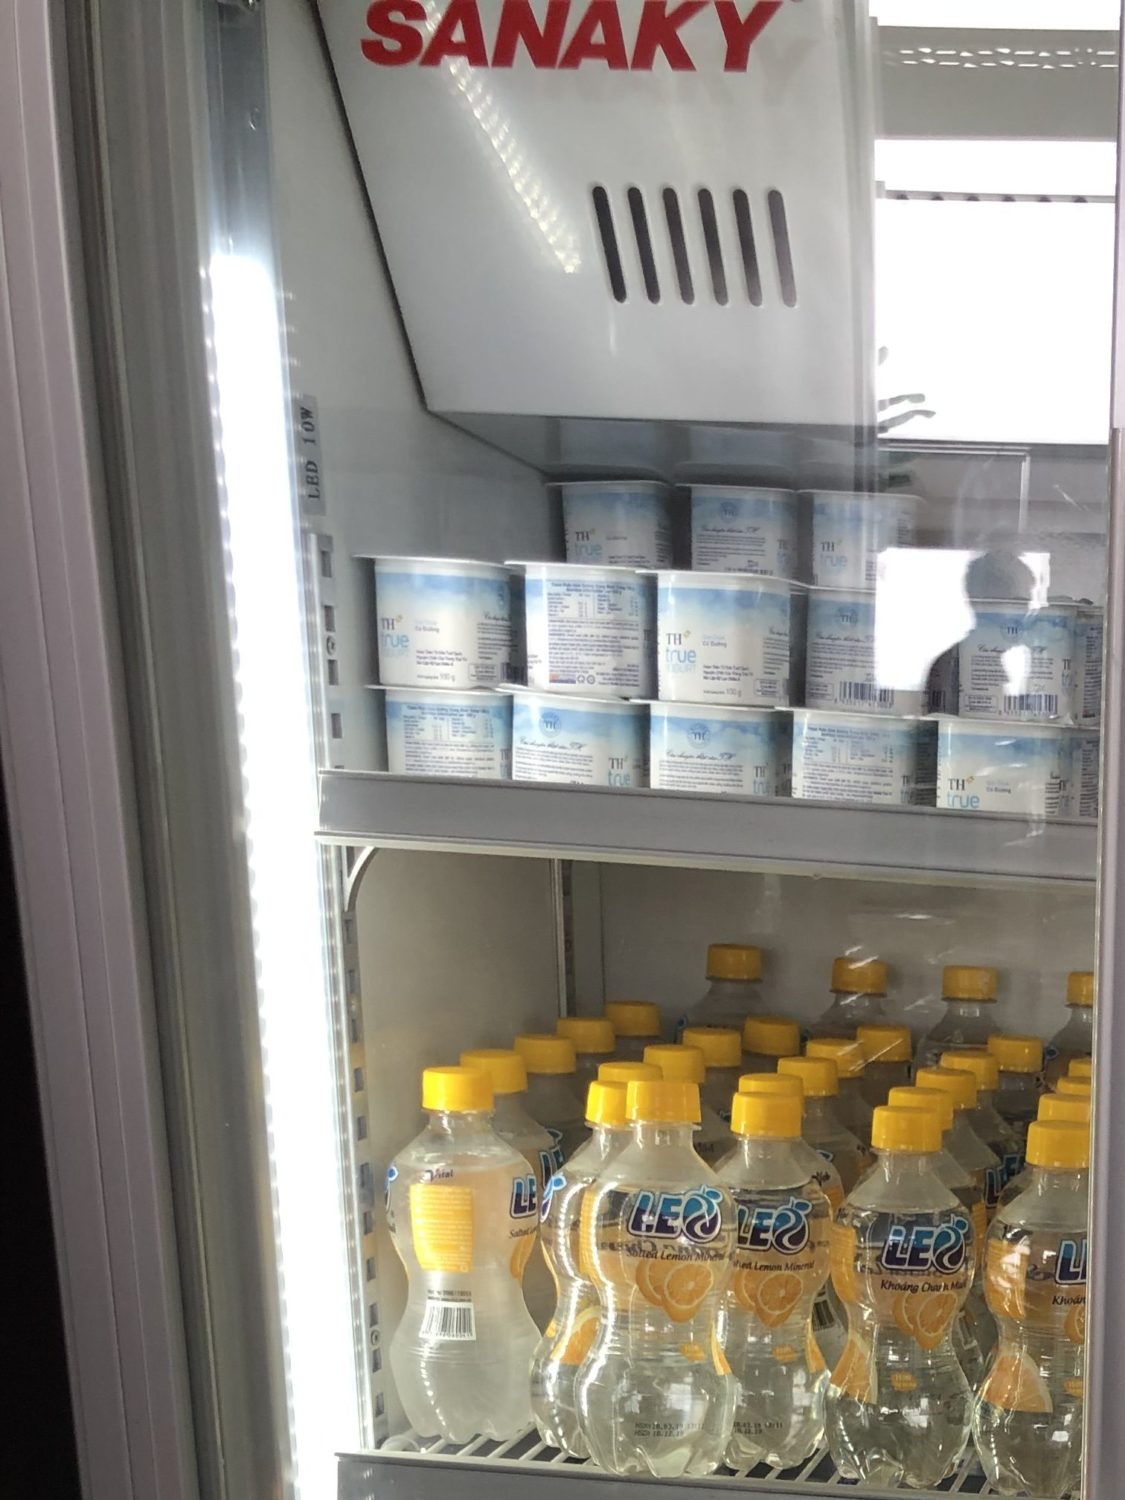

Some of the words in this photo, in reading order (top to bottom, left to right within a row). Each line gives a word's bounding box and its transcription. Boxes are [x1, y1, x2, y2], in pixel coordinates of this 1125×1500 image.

[360, 0, 783, 72] SANAKY
[305, 460, 321, 500] LED
[575, 530, 590, 541] TH
[820, 541, 835, 552] TH
[381, 617, 395, 630] TH
[666, 633, 682, 645] TH
[666, 647, 697, 664] true
[948, 779, 965, 791] TH
[947, 792, 980, 808] true
[1051, 1295, 1087, 1306] Khoán
